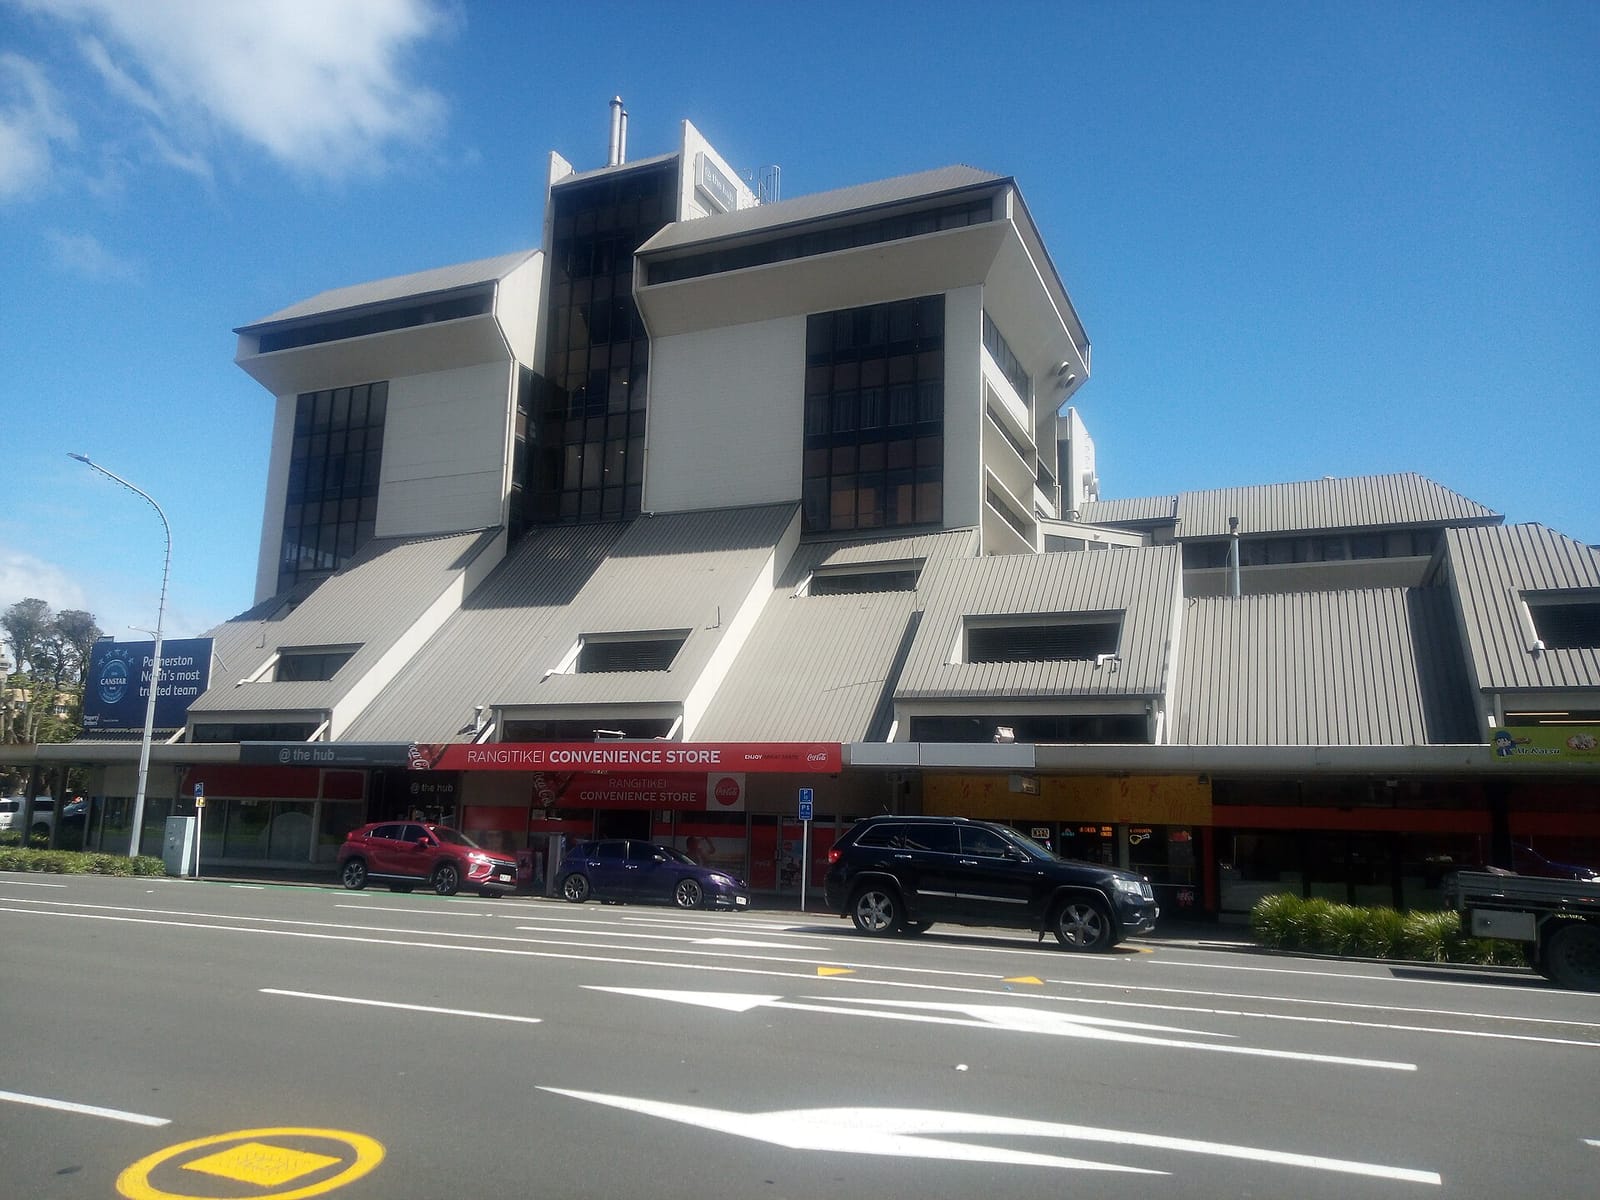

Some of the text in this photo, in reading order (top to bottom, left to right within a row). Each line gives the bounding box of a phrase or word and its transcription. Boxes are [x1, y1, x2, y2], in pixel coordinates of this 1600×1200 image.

[142, 655, 193, 668] Pamerston
[100, 677, 127, 686] CANSTAR
[141, 669, 200, 682] Noth's most
[139, 684, 198, 697] truted team
[278, 748, 335, 763] @ the hub
[467, 750, 721, 764] RANGITIKEI CONVENIENCE STORE
[421, 783, 435, 792] the
[436, 783, 454, 793] hub
[608, 778, 667, 788] RANGITIKEI
[580, 791, 697, 802] CONVENIENCE STORE
